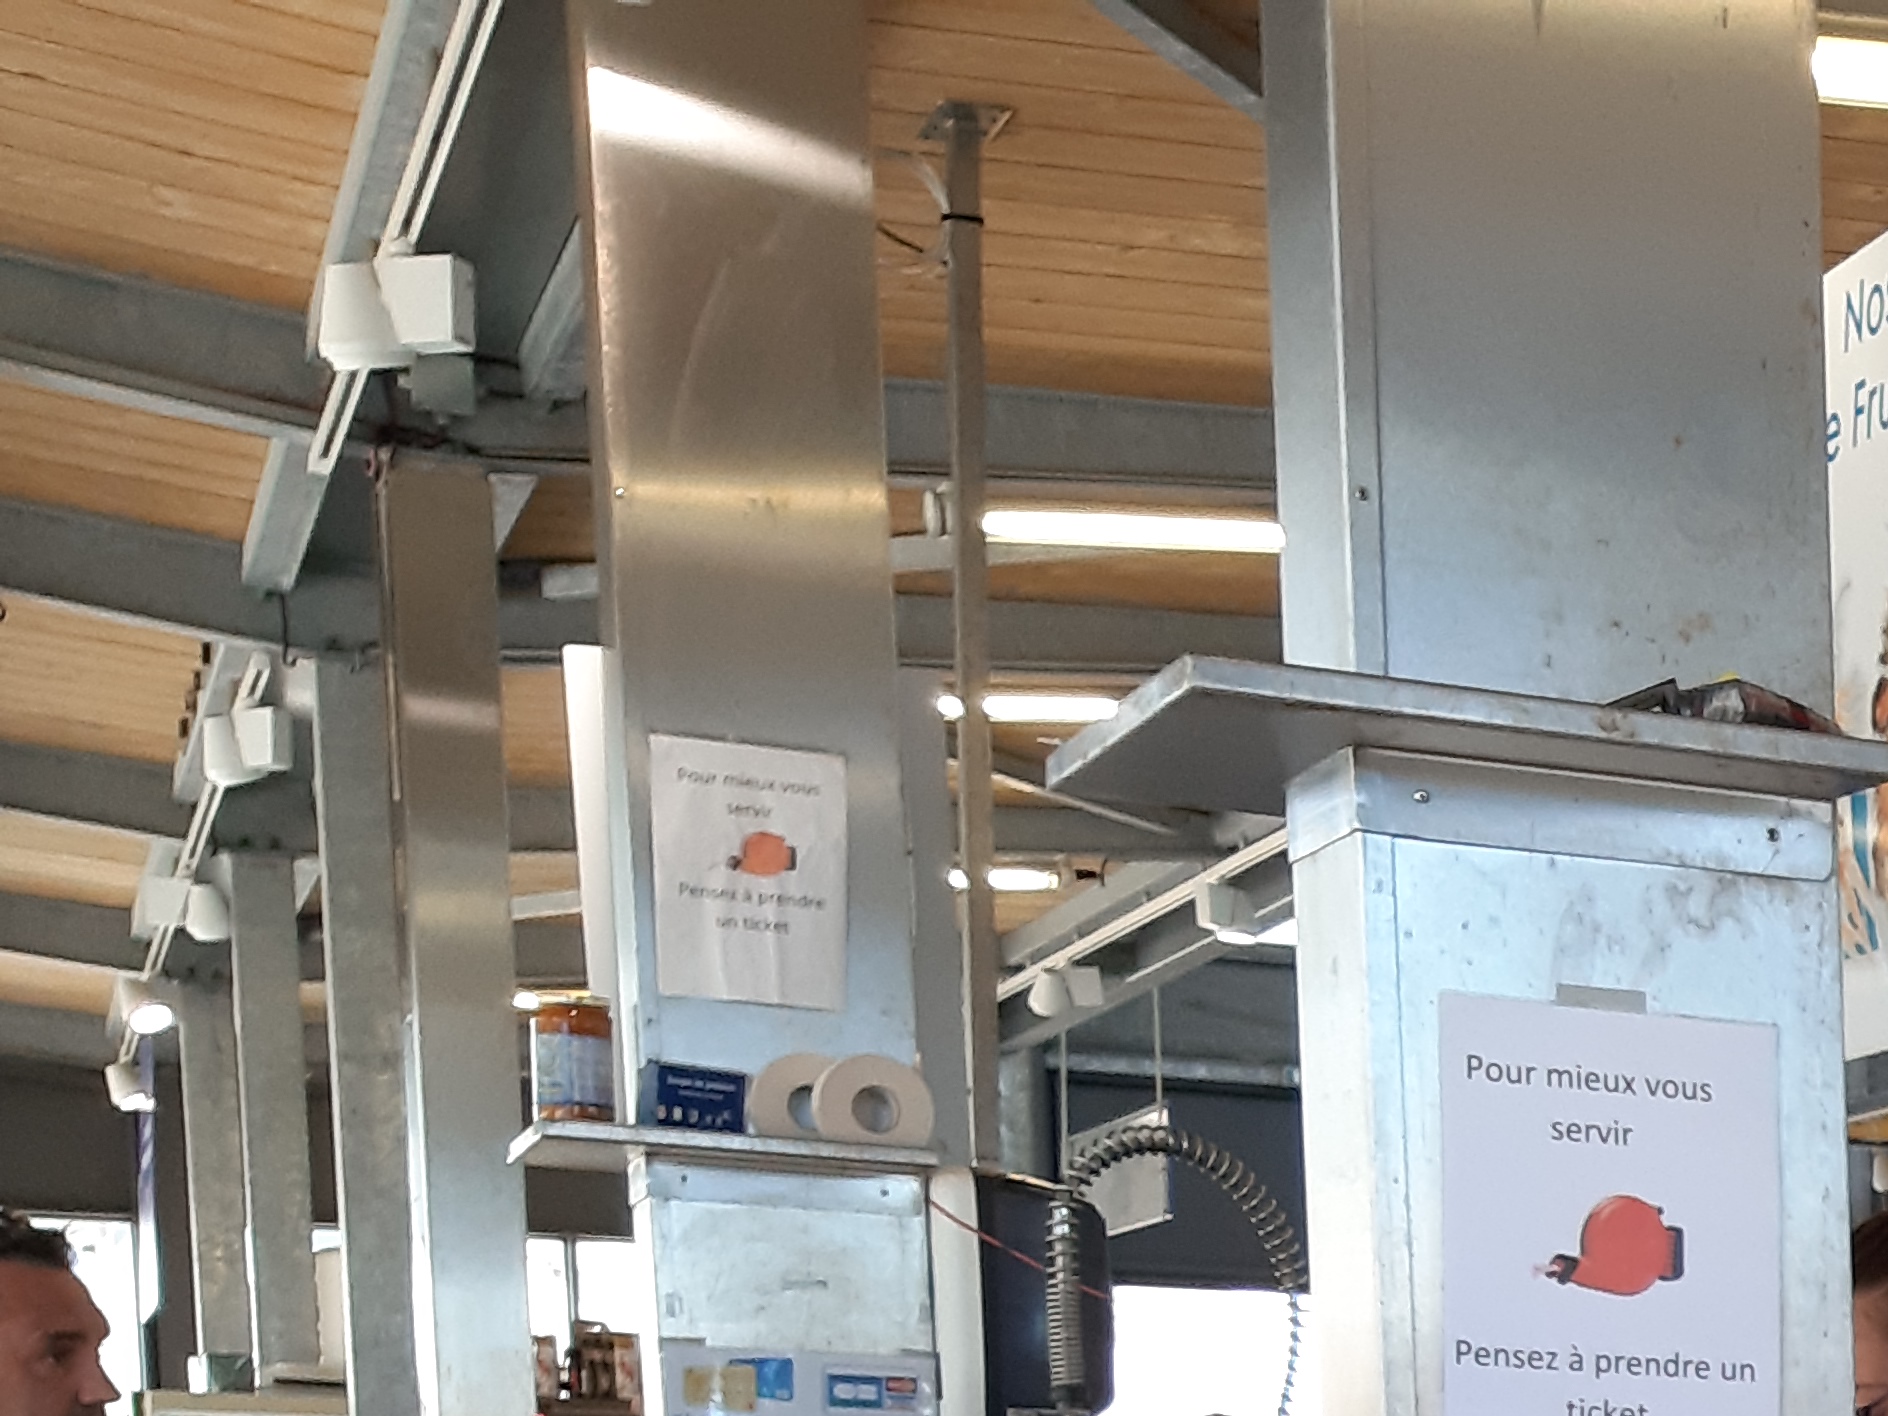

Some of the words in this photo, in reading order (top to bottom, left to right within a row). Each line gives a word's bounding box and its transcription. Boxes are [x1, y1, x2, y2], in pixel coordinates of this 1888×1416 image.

[1826, 412, 1842, 463] e
[1465, 1053, 1537, 1087] Pour
[1546, 1064, 1636, 1096] mieux
[1644, 1076, 1713, 1103] vous
[1551, 1118, 1634, 1147] servir
[1455, 1339, 1559, 1372] Pensez
[1568, 1344, 1585, 1373] à
[1595, 1350, 1710, 1386] prendre
[1720, 1357, 1756, 1384] un
